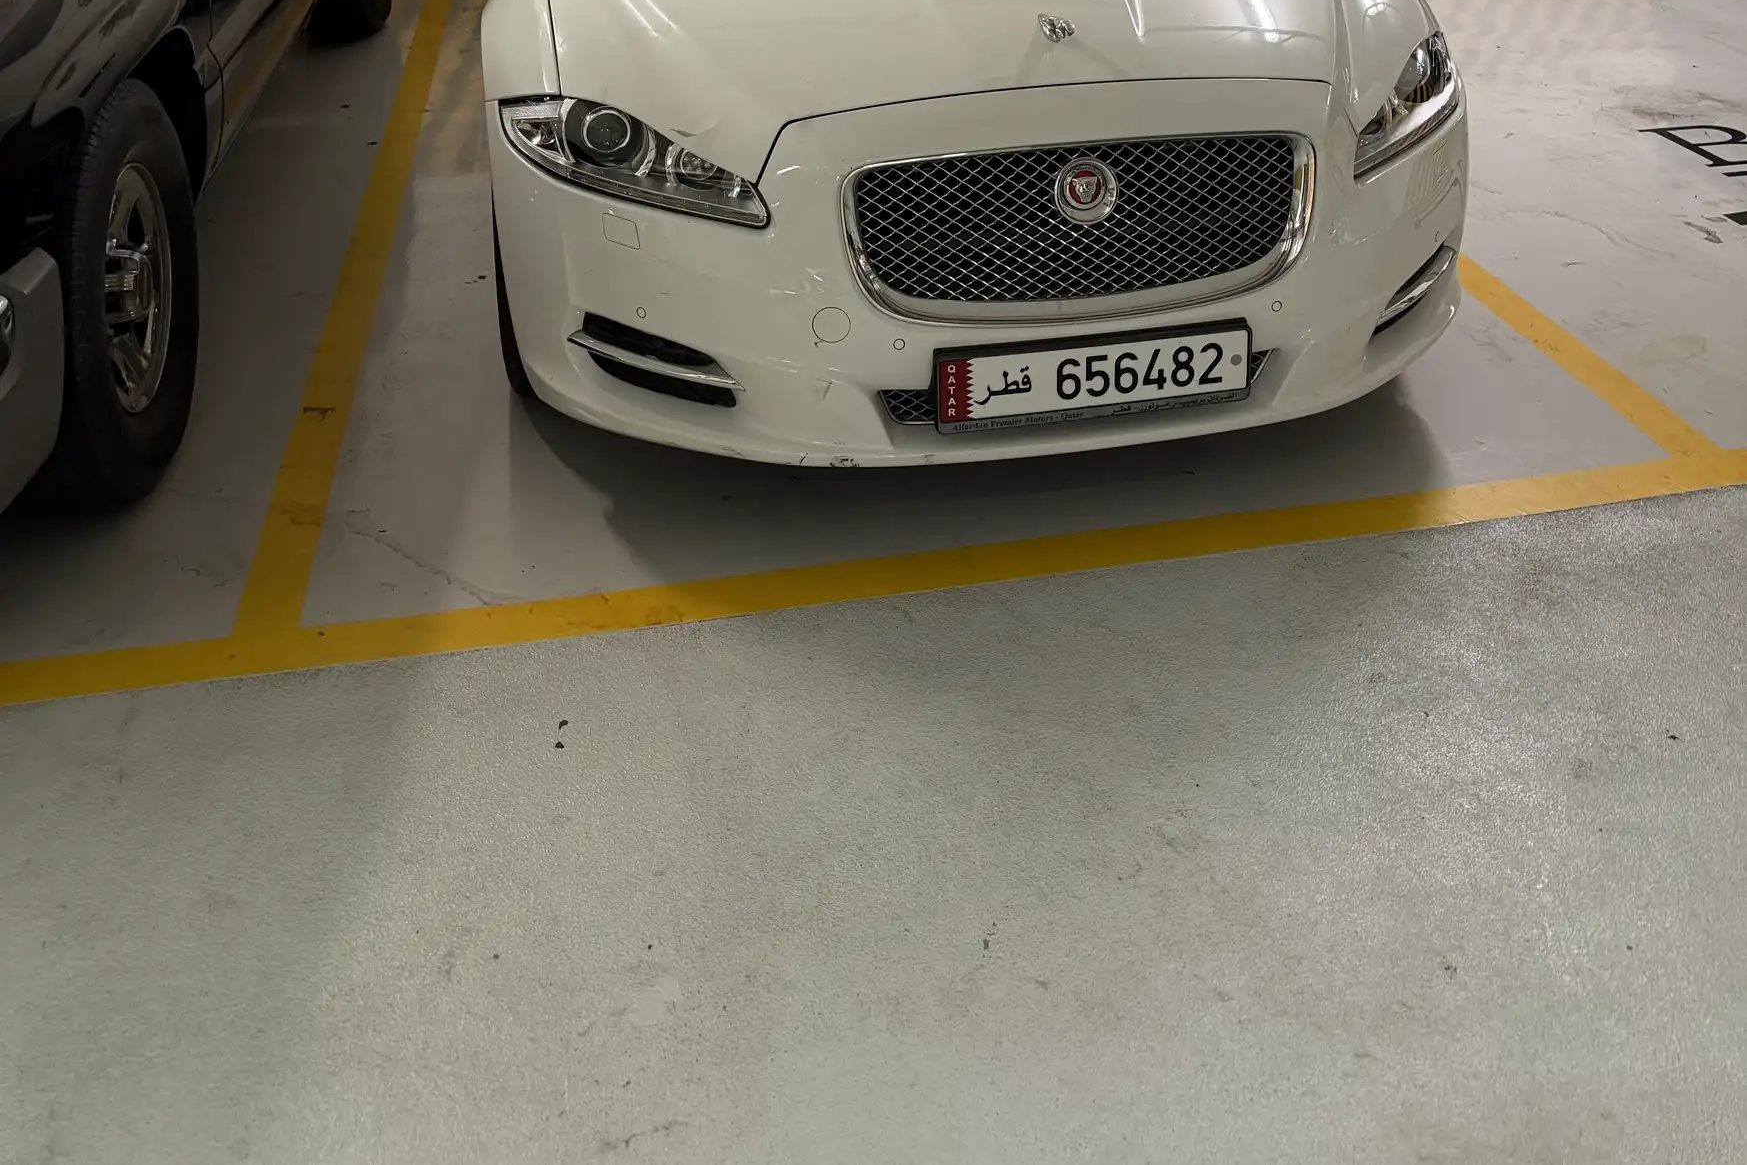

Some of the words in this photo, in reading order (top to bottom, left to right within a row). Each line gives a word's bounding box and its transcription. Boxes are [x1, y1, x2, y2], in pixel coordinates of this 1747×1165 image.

[947, 364, 957, 417] QATAR
[973, 365, 1032, 405] قطر
[1056, 342, 1224, 400] 656482
[953, 421, 988, 432] Alfardan
[991, 418, 1023, 428] Premier
[1025, 415, 1053, 425] Motors
[1061, 411, 1085, 420] Qatar
